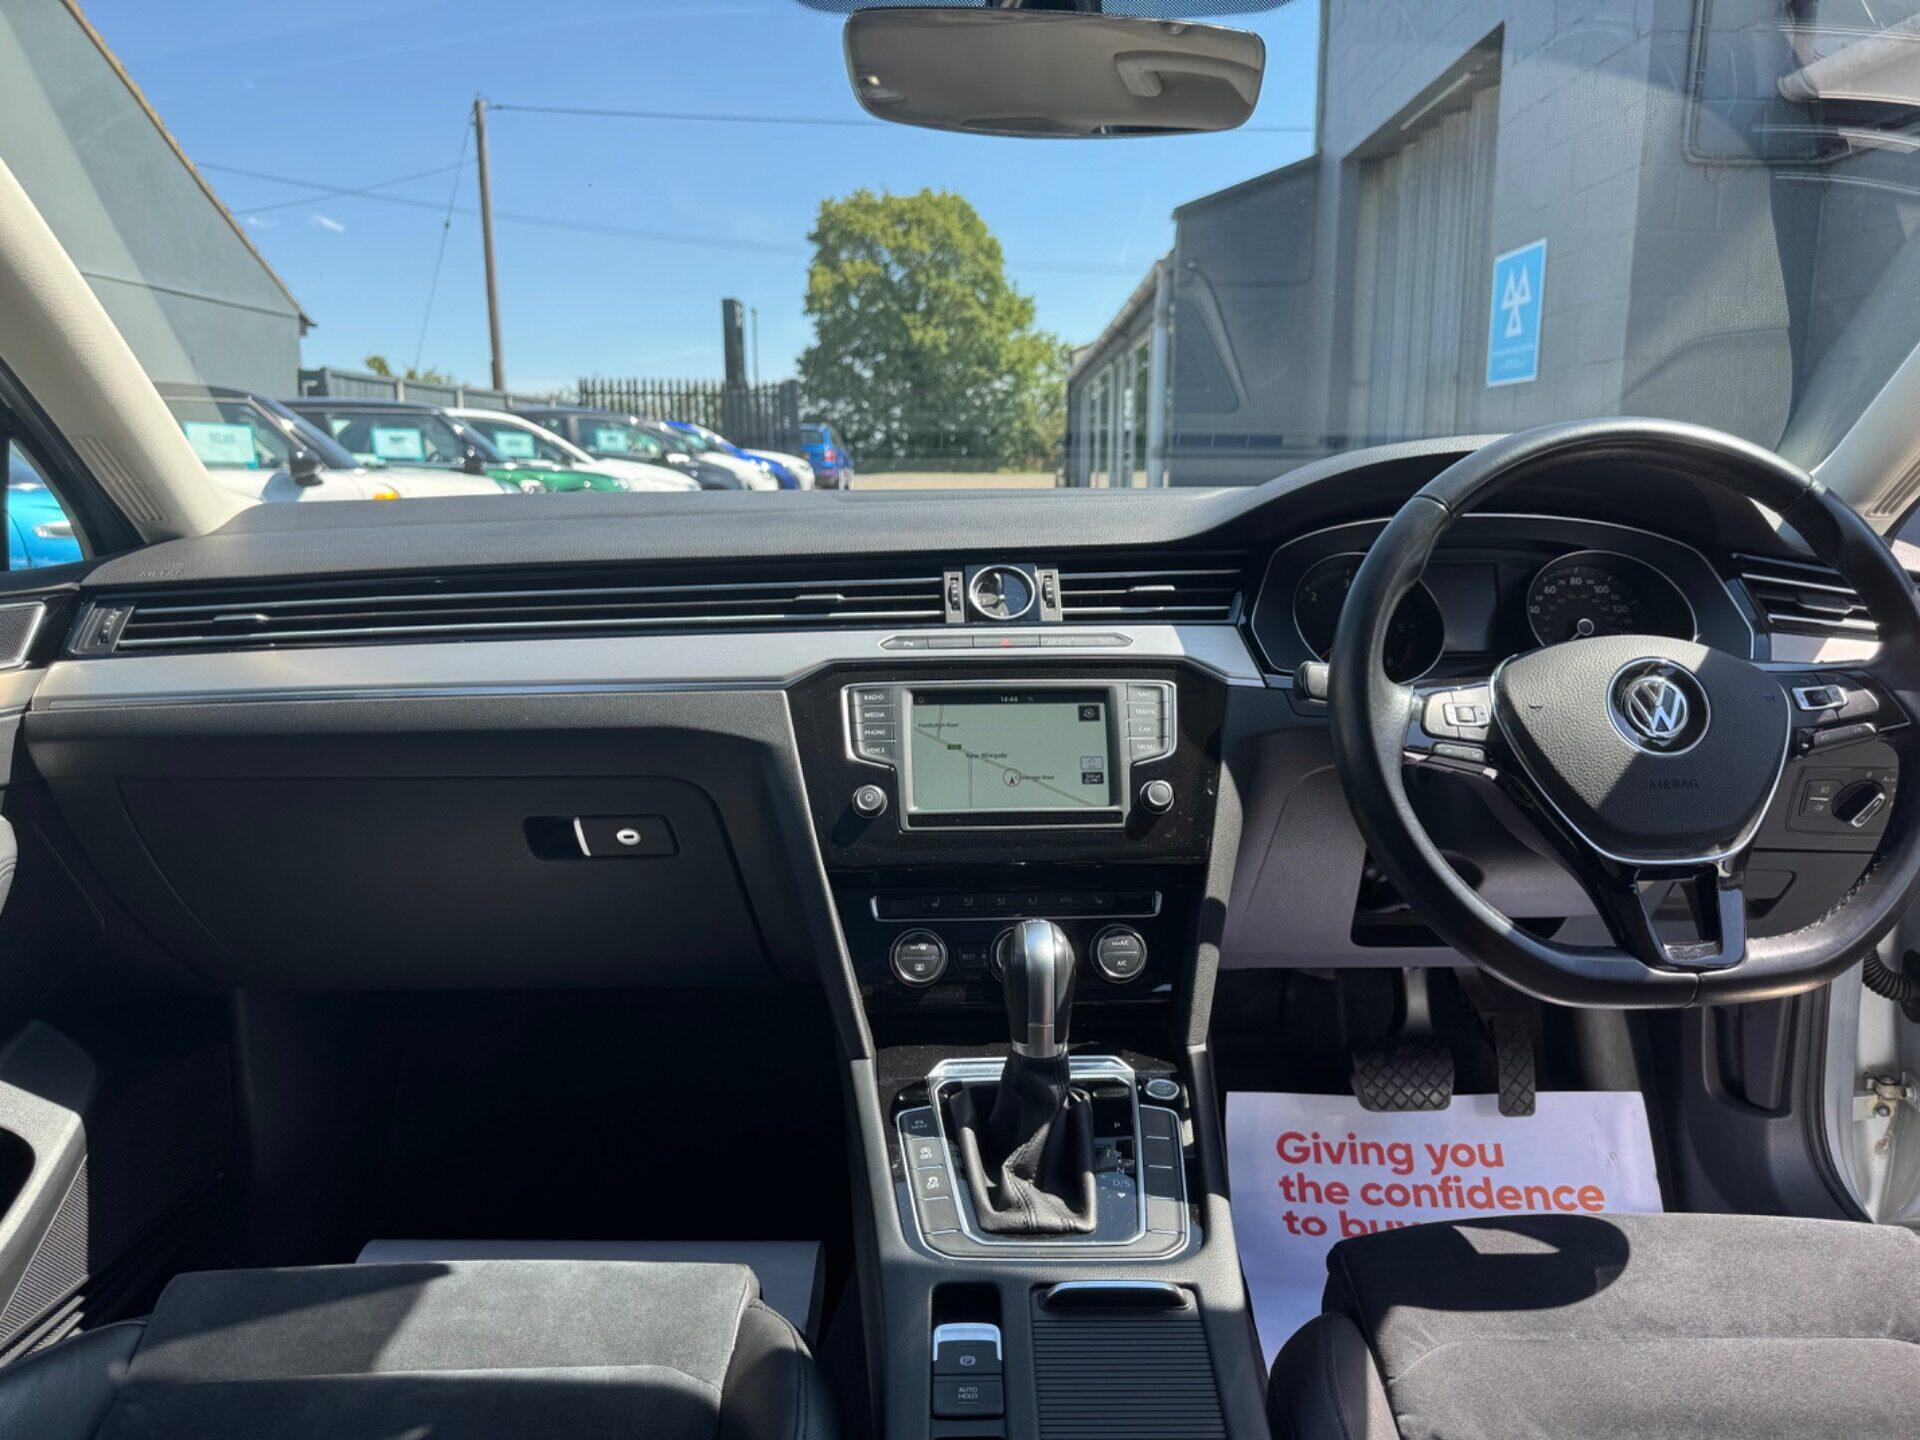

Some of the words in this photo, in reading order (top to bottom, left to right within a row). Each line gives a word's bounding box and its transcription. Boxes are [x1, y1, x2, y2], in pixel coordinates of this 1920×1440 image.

[1570, 577, 1582, 586] 80
[1544, 586, 1557, 594] 60
[1594, 585, 1610, 594] 100
[1612, 605, 1629, 614] 120
[863, 693, 884, 701] RADIO
[864, 711, 885, 719] MEDIA
[864, 728, 886, 736] PHONE
[866, 746, 885, 754] VOICE
[1649, 777, 1699, 790] AIRBAG
[1276, 1131, 1414, 1175] Giving
[1425, 1142, 1504, 1176] you
[1112, 1179, 1131, 1187] D/S
[1279, 1173, 1349, 1204] the
[1360, 1176, 1605, 1213] confidence
[1283, 1210, 1327, 1237] to
[1339, 1210, 1421, 1238] bu
[958, 1386, 978, 1394] AUTO
